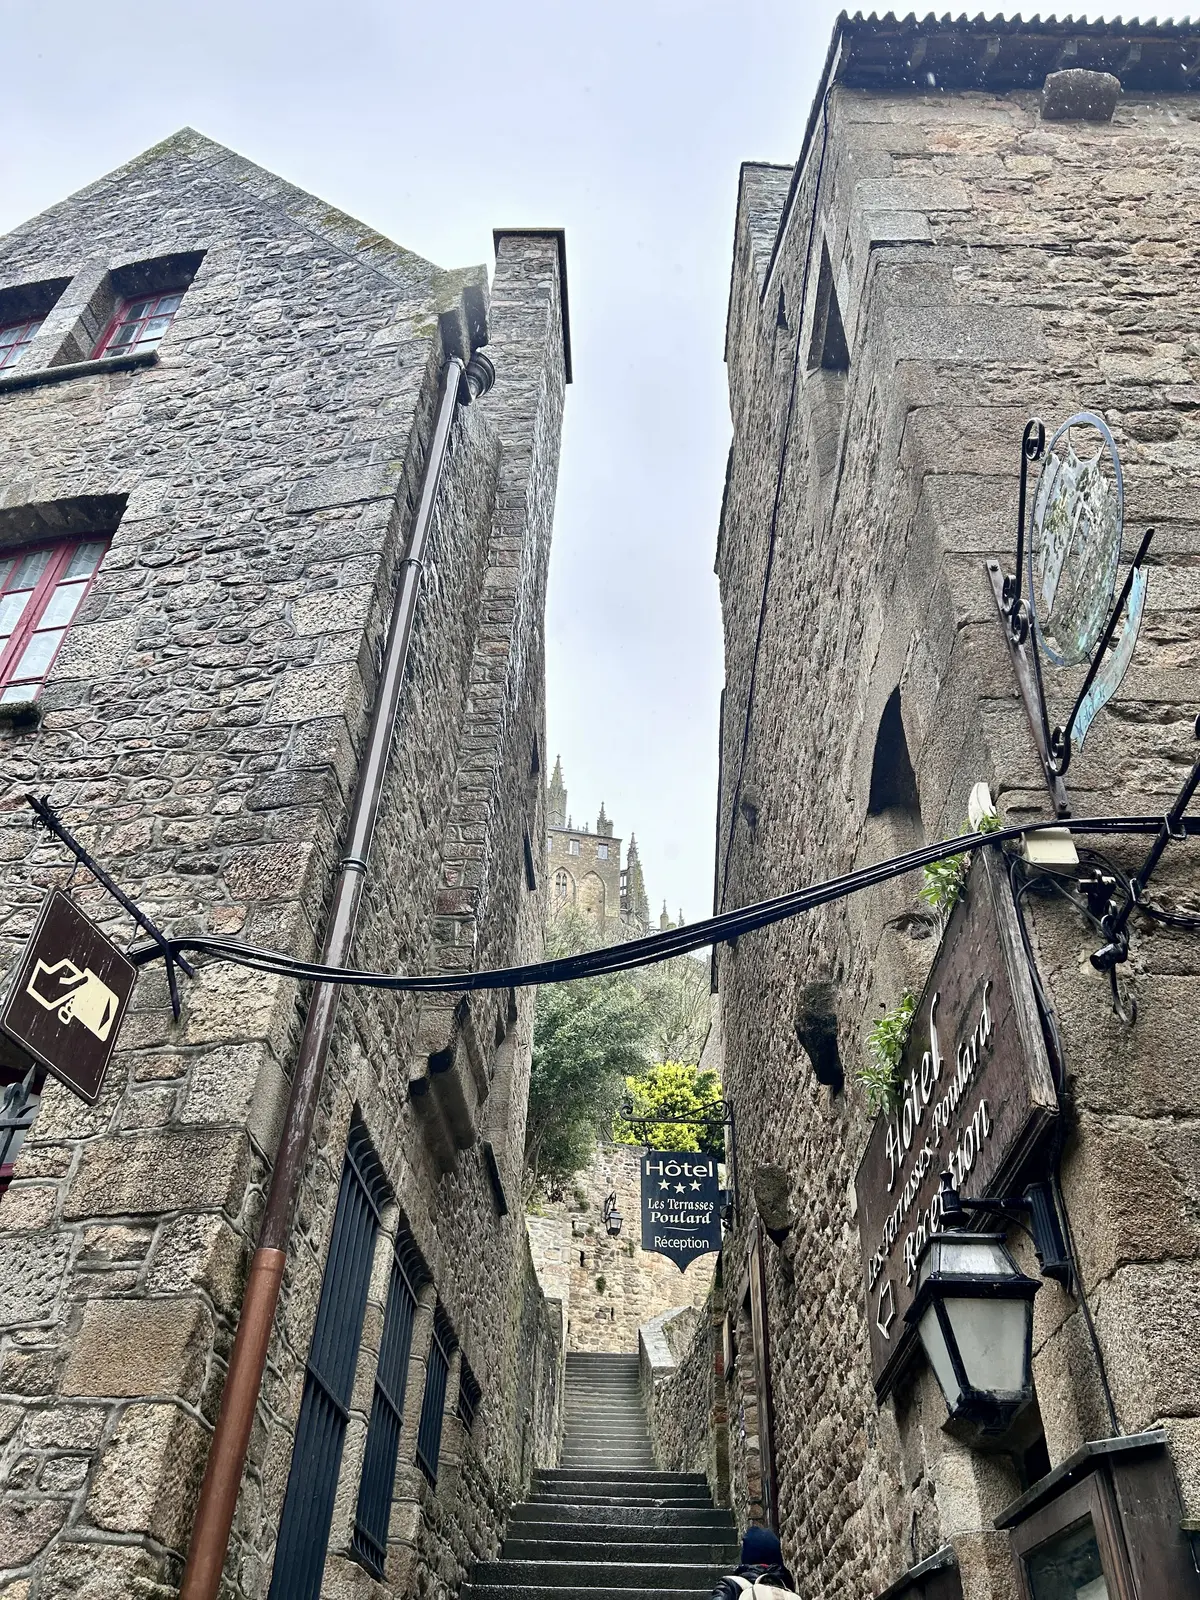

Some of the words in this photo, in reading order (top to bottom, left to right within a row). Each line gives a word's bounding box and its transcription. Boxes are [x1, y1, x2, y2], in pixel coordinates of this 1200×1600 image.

[886, 992, 943, 1192] Hôtel
[869, 1245, 884, 1291] Les
[883, 1137, 933, 1257] Terrasses
[932, 981, 992, 1148] Poulard
[645, 1160, 714, 1178] Hôtel
[647, 1198, 665, 1210] Les
[667, 1198, 714, 1211] Terrasses
[650, 1211, 712, 1224] Poulard
[654, 1235, 710, 1251] Réception
